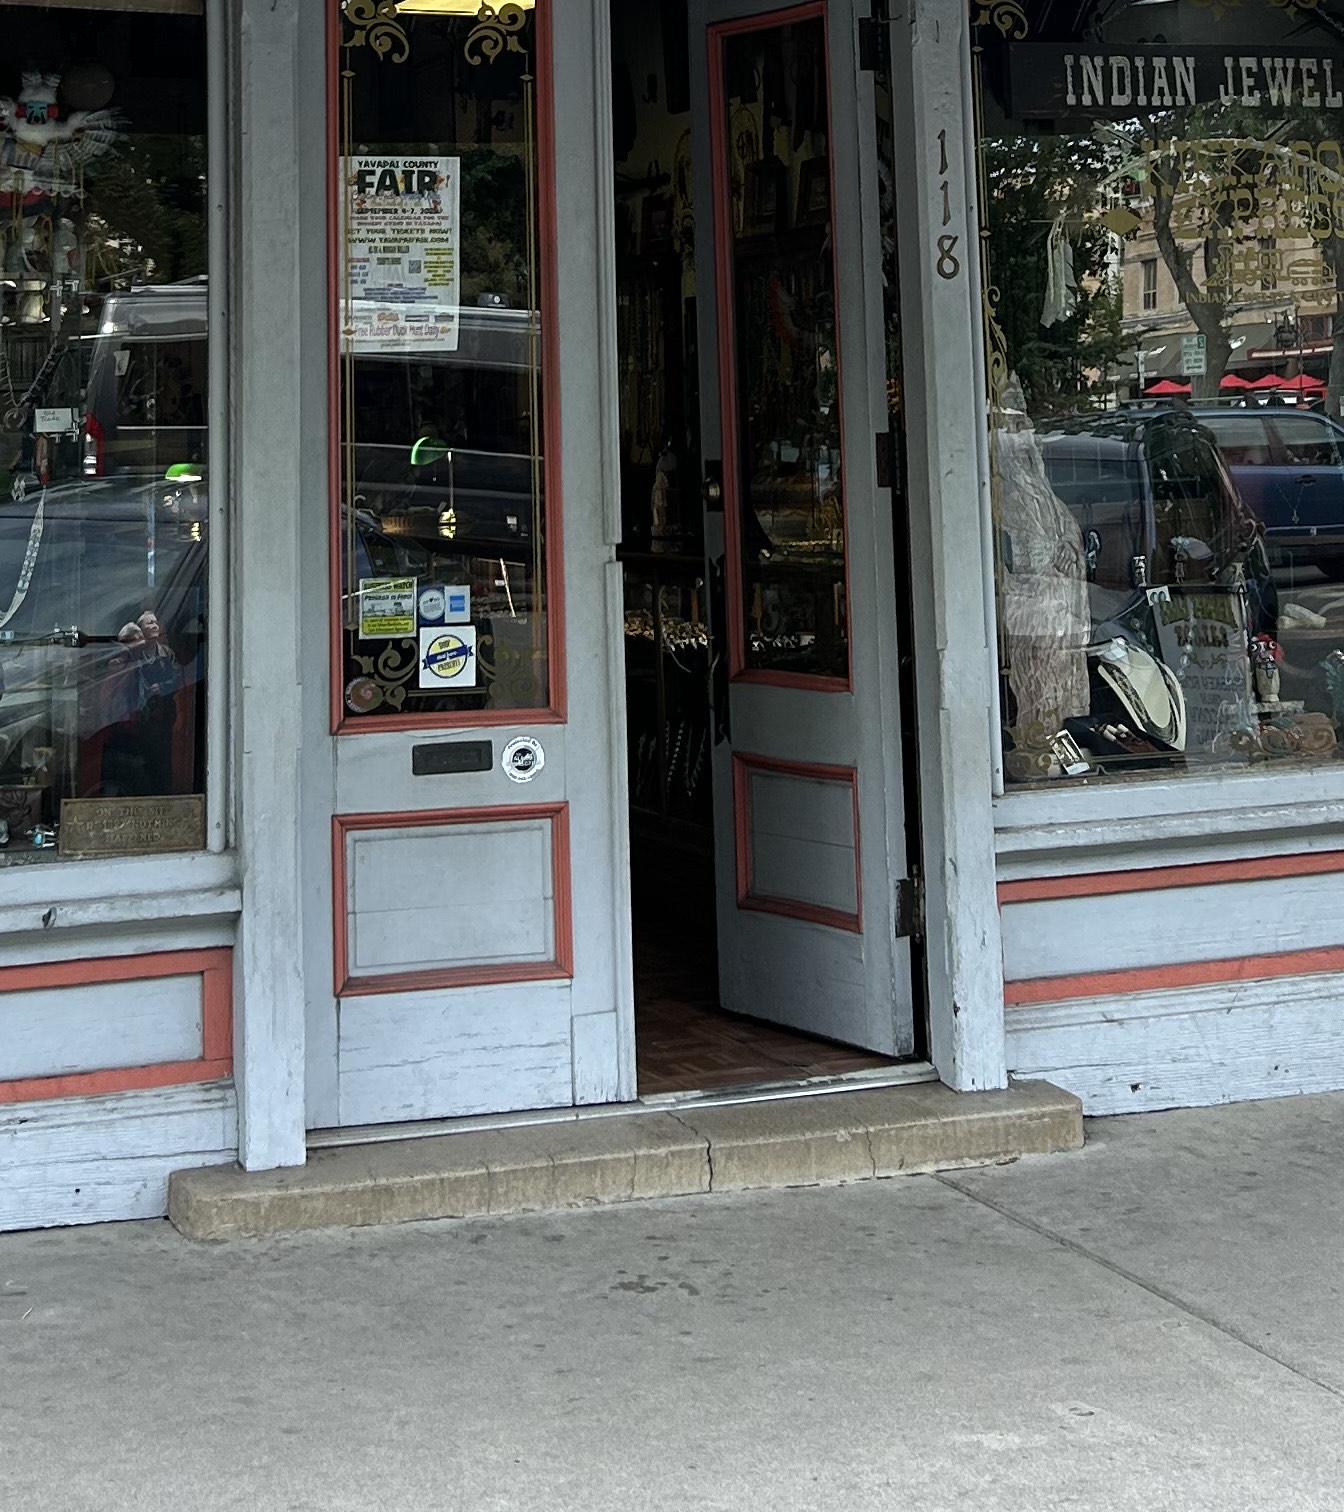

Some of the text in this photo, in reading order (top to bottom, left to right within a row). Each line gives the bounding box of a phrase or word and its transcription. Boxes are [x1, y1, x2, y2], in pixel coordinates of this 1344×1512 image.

[1063, 54, 1197, 107] INDIAN
[403, 160, 439, 169] COUNTY
[356, 169, 438, 196] FAIR
